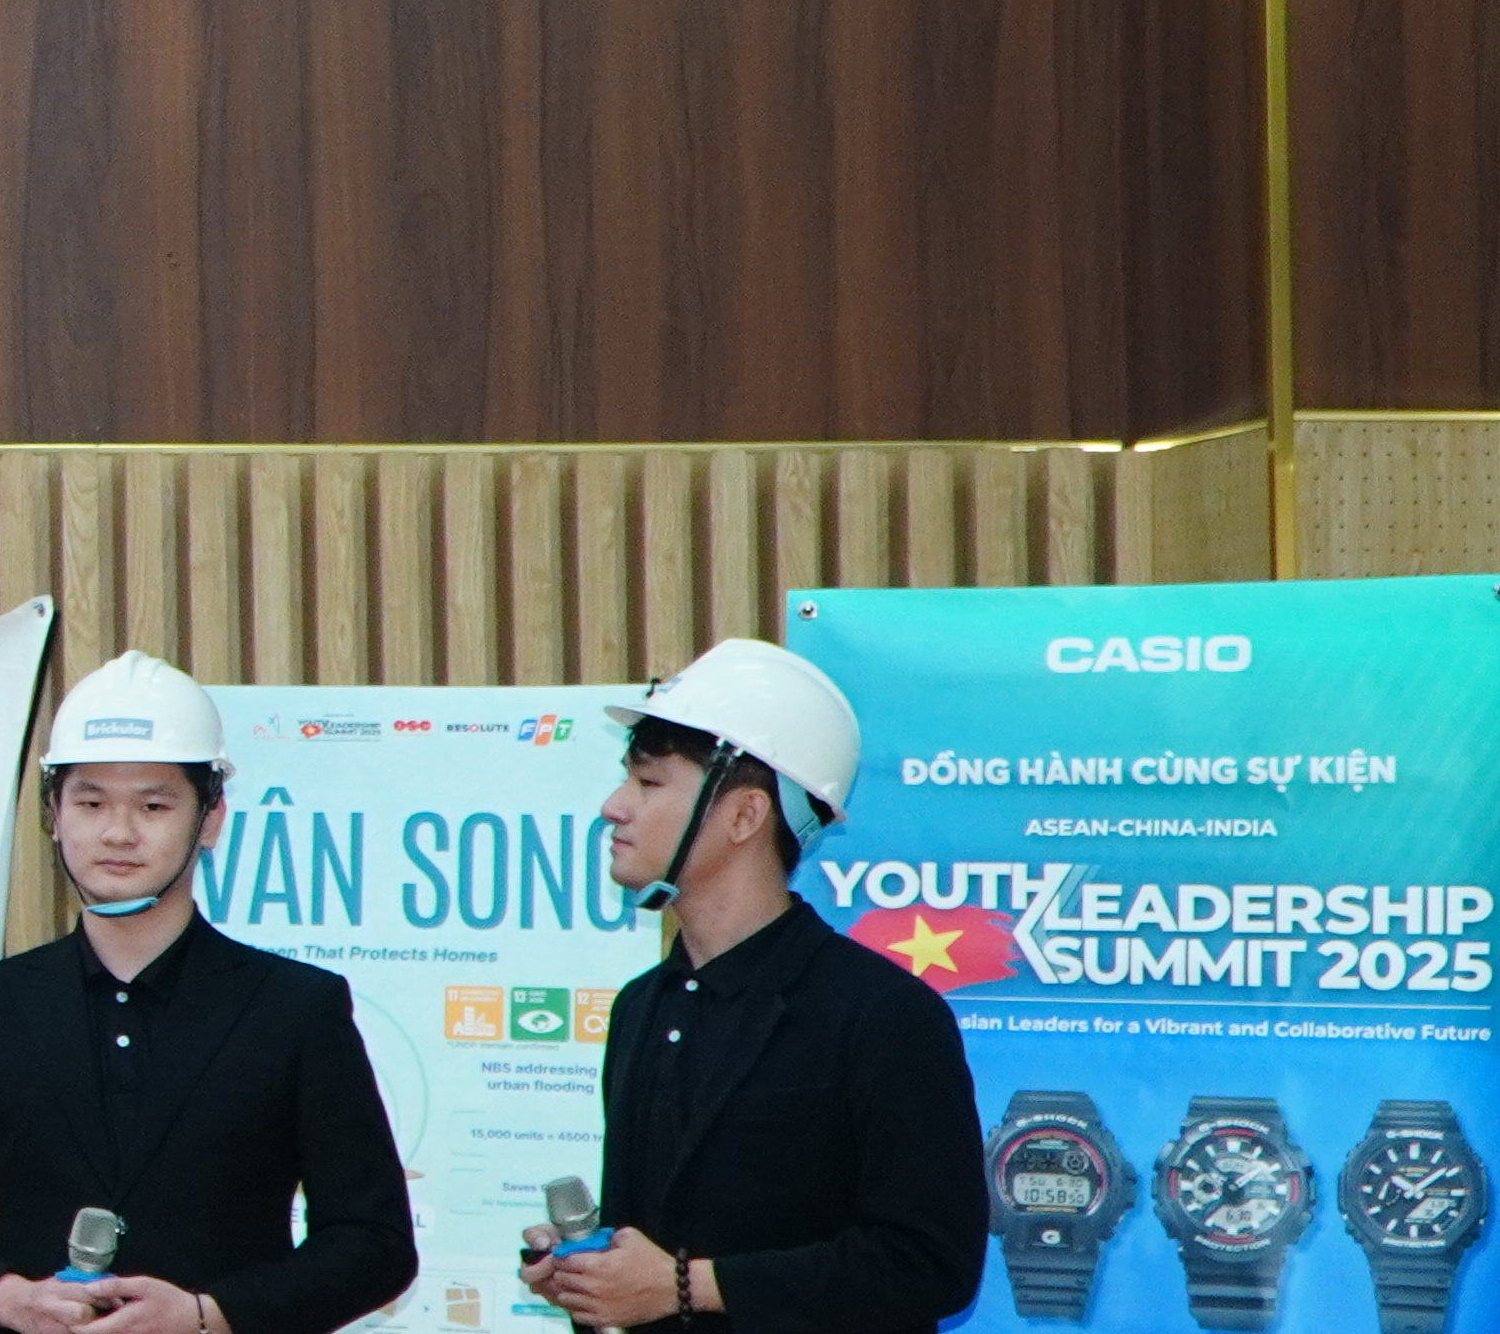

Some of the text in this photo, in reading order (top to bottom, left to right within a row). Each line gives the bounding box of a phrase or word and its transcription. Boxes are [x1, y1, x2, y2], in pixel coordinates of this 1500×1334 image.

[1046, 635, 1251, 673] CASIO
[87, 722, 151, 739] Brickular
[518, 715, 575, 746] FPT
[902, 747, 1396, 792] ĐỒNG HÀNH CÙNG SỰ KIỆN
[1025, 819, 1277, 838] ASEAN-CHINA-INDIA
[820, 861, 1493, 936] YOUTH LEADERSHIP
[305, 945, 497, 962] That Protects Homes
[1049, 940, 1492, 992] SUMMIT 2025
[1008, 1017, 1491, 1041] Leaders for a Vibrant and Collaborative Future
[515, 1063, 597, 1078] addressing
[488, 1080, 594, 1095] urban flooding
